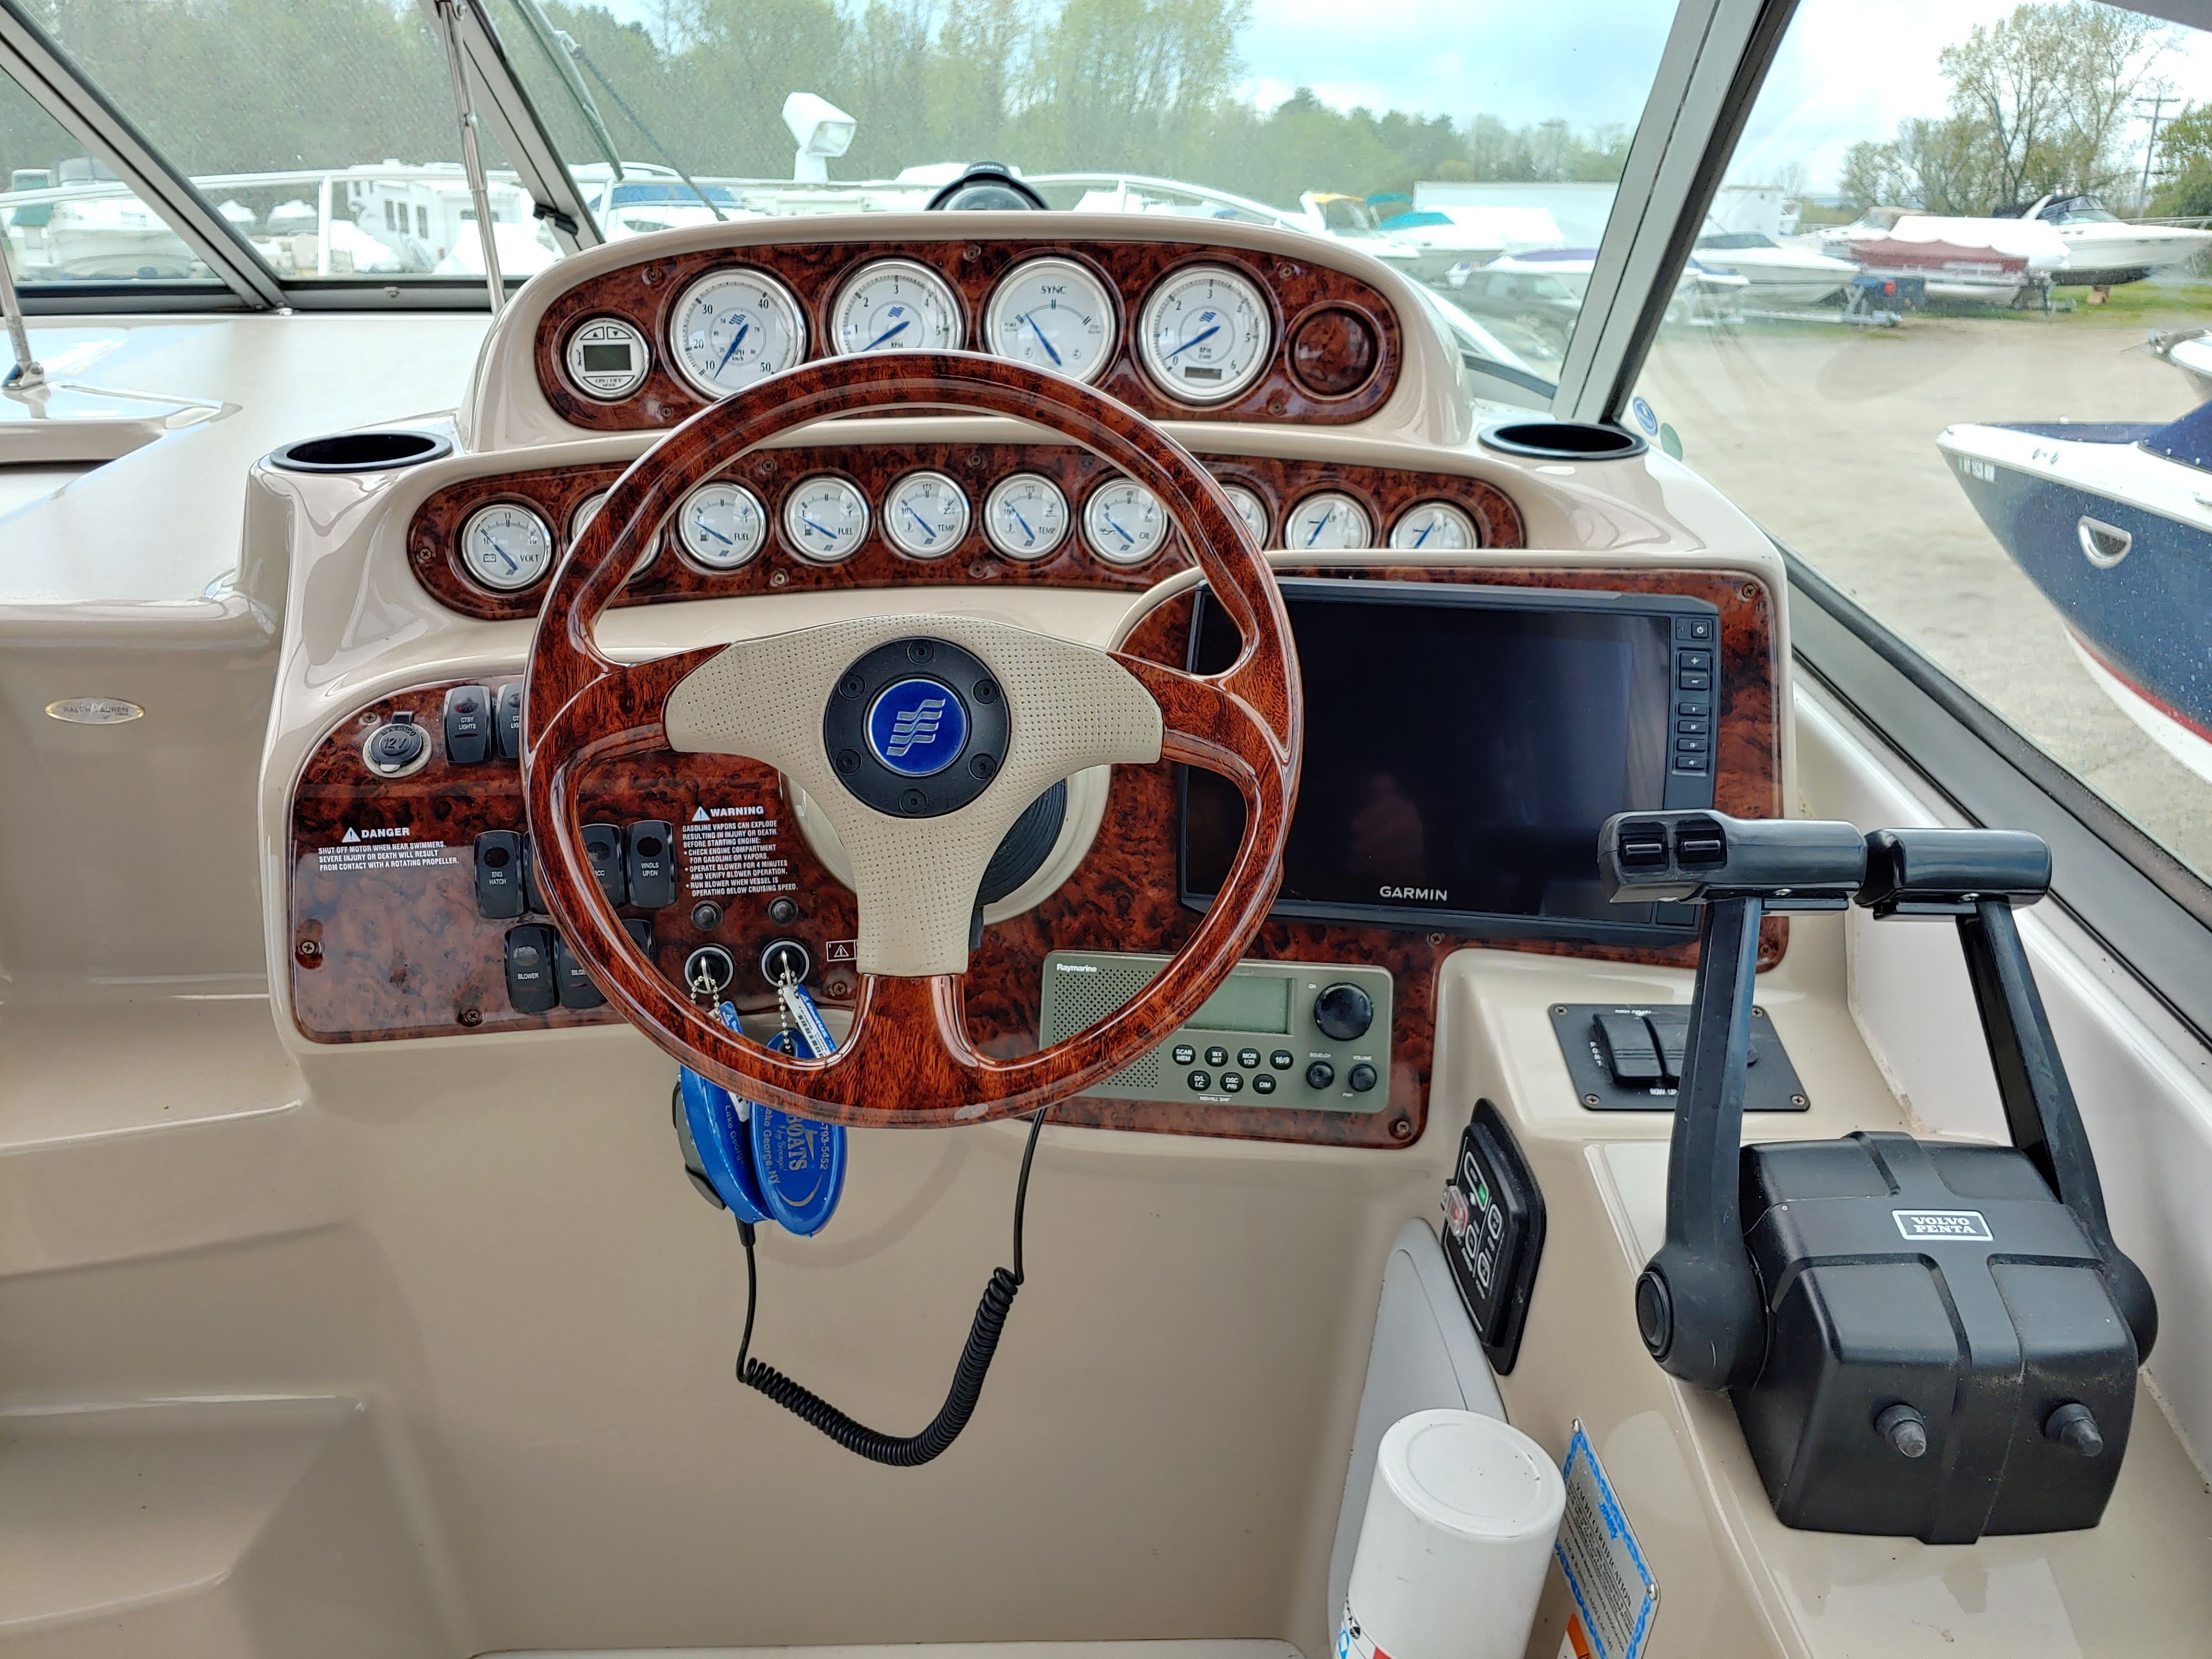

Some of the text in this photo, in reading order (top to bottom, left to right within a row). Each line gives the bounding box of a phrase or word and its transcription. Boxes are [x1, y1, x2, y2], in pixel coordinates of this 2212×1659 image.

[894, 284, 899, 294] 3
[1041, 286, 1066, 295] SYNC
[1207, 289, 1212, 299] 3
[758, 299, 769, 309] 40
[864, 297, 868, 307] 2
[1176, 301, 1182, 311] 2
[702, 304, 713, 314] 30
[854, 325, 858, 334] 1
[936, 326, 940, 336] 5
[1165, 328, 1169, 337] 1
[1245, 333, 1250, 342] 5
[693, 339, 704, 349] 20
[706, 360, 715, 370] 10
[1172, 357, 1178, 365] 0
[1231, 360, 1236, 370] 6
[760, 362, 771, 372] 50
[520, 554, 539, 562] VOLT
[384, 738, 407, 749] 12V
[710, 806, 764, 817] WARNING
[682, 824, 712, 832] GASOLINE
[713, 822, 736, 831] VAPORS
[362, 827, 409, 838] DANGER
[410, 841, 447, 849] SWIMMERS.
[684, 840, 706, 848] BEFORE
[708, 838, 736, 847] STARTING
[709, 847, 731, 855] ENGINE
[732, 844, 776, 853] COMPARTMENT
[339, 862, 366, 870] CONTACT
[391, 859, 421, 867] ROTATING
[422, 857, 459, 866] PROPELLER.
[703, 855, 732, 863] GASOLINE
[731, 878, 748, 887] WHEN
[749, 877, 771, 885] VESSEL
[692, 888, 725, 897] OPERATING
[748, 884, 776, 893] CRUISING
[777, 883, 798, 891] SPEED.
[1380, 885, 1447, 901] GARMIN
[1057, 963, 1097, 972] Raymarine
[1590, 1041, 1602, 1067] PORT
[725, 1105, 733, 1128] Lake
[764, 1107, 773, 1126] ake
[769, 1170, 780, 1183] NY
[786, 1114, 808, 1170] BOATS
[1910, 1217, 1970, 1225] VOLVO
[1913, 1224, 1977, 1233] PENTA
[1592, 1519, 1632, 1607] CERTIFICATION
